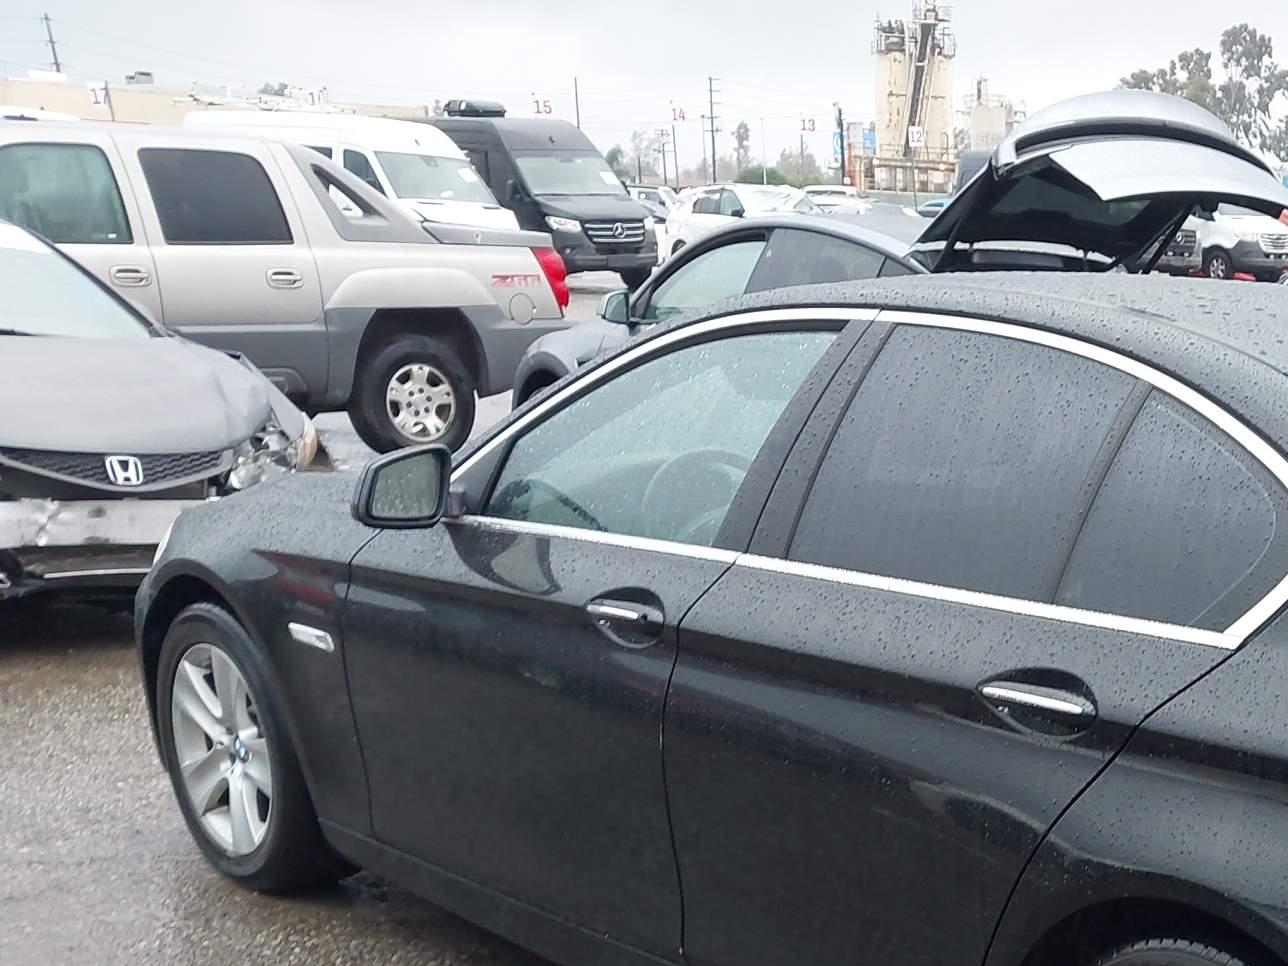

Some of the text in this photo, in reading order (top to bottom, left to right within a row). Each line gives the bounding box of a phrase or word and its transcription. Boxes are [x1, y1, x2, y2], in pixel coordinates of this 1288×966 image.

[533, 99, 553, 114] 15
[672, 108, 686, 121] 14
[800, 119, 816, 132] 13
[910, 130, 922, 143] 12
